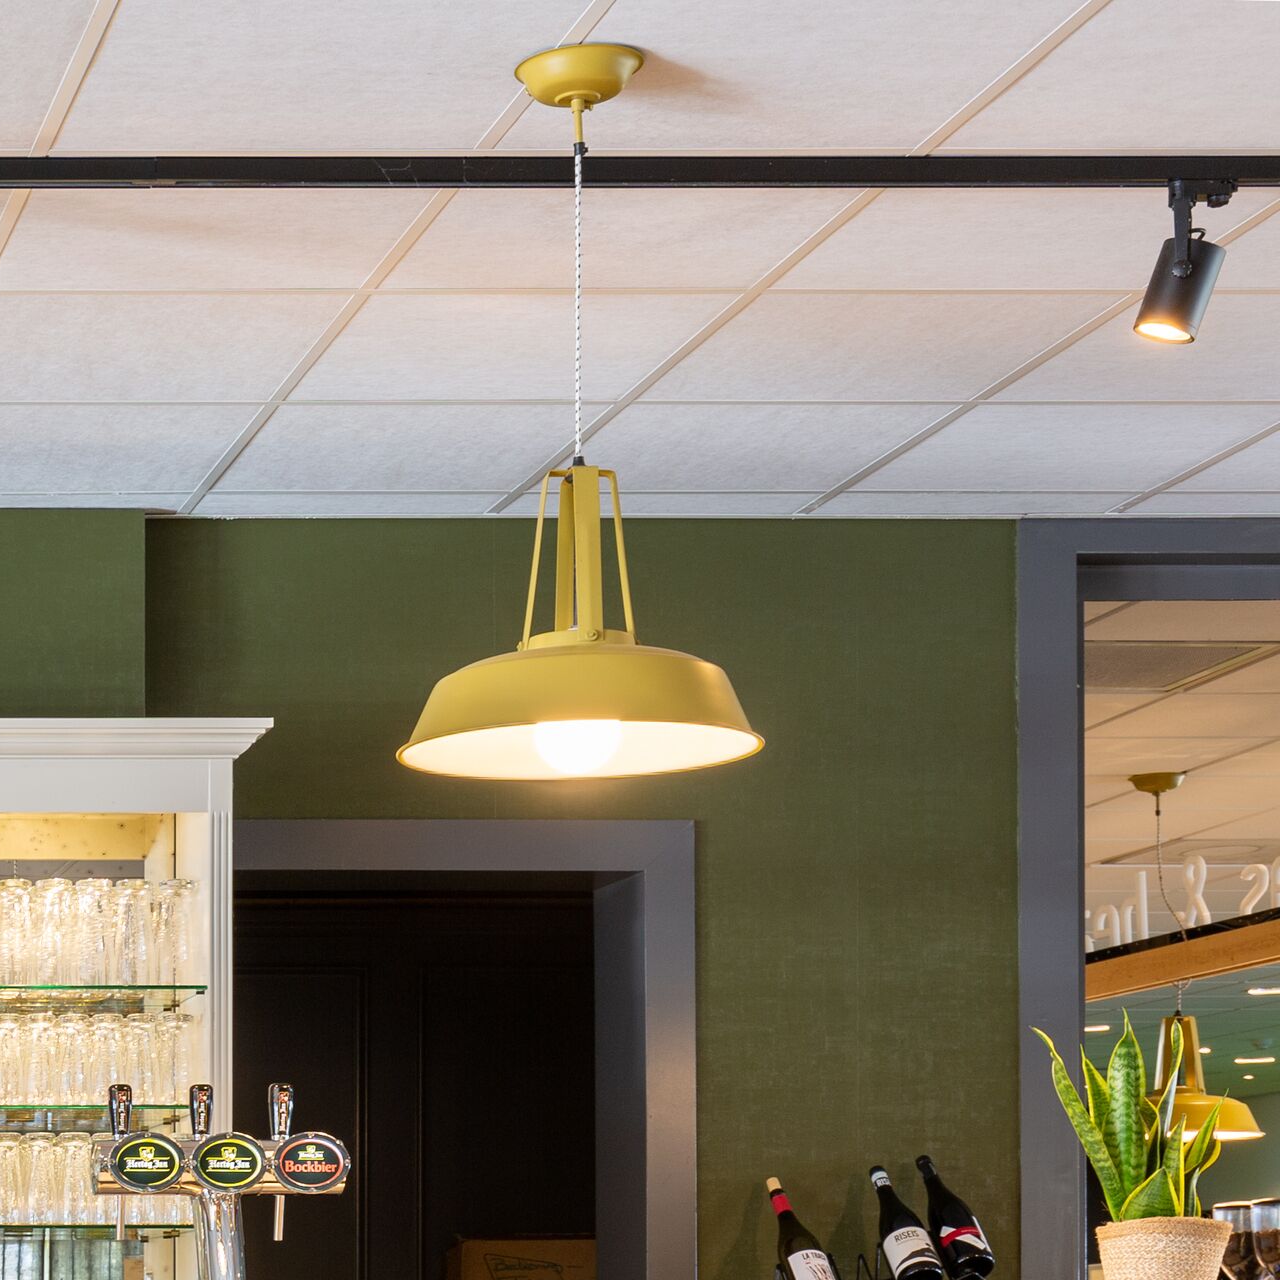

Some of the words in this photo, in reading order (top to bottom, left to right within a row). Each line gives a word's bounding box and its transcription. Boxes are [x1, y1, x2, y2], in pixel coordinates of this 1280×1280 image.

[126, 1160, 153, 1169] Hertog
[208, 1160, 236, 1169] Hertog
[285, 1160, 338, 1173] Bockbier
